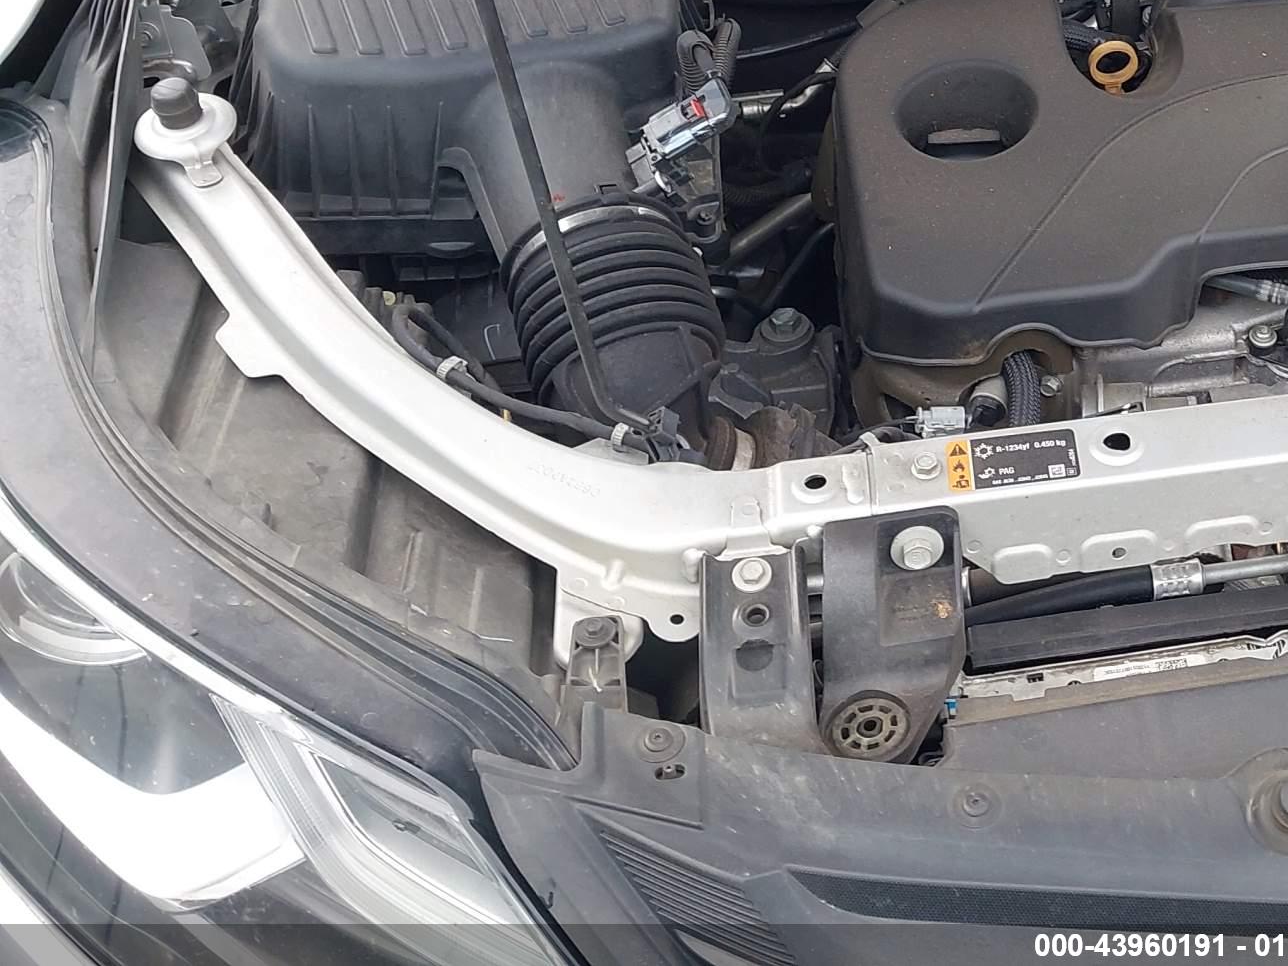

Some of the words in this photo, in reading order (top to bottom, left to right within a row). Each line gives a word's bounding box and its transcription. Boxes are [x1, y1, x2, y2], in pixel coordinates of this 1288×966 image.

[996, 443, 1030, 452] R-1234yf
[1034, 440, 1055, 448] 0.450
[999, 467, 1015, 475] PAG
